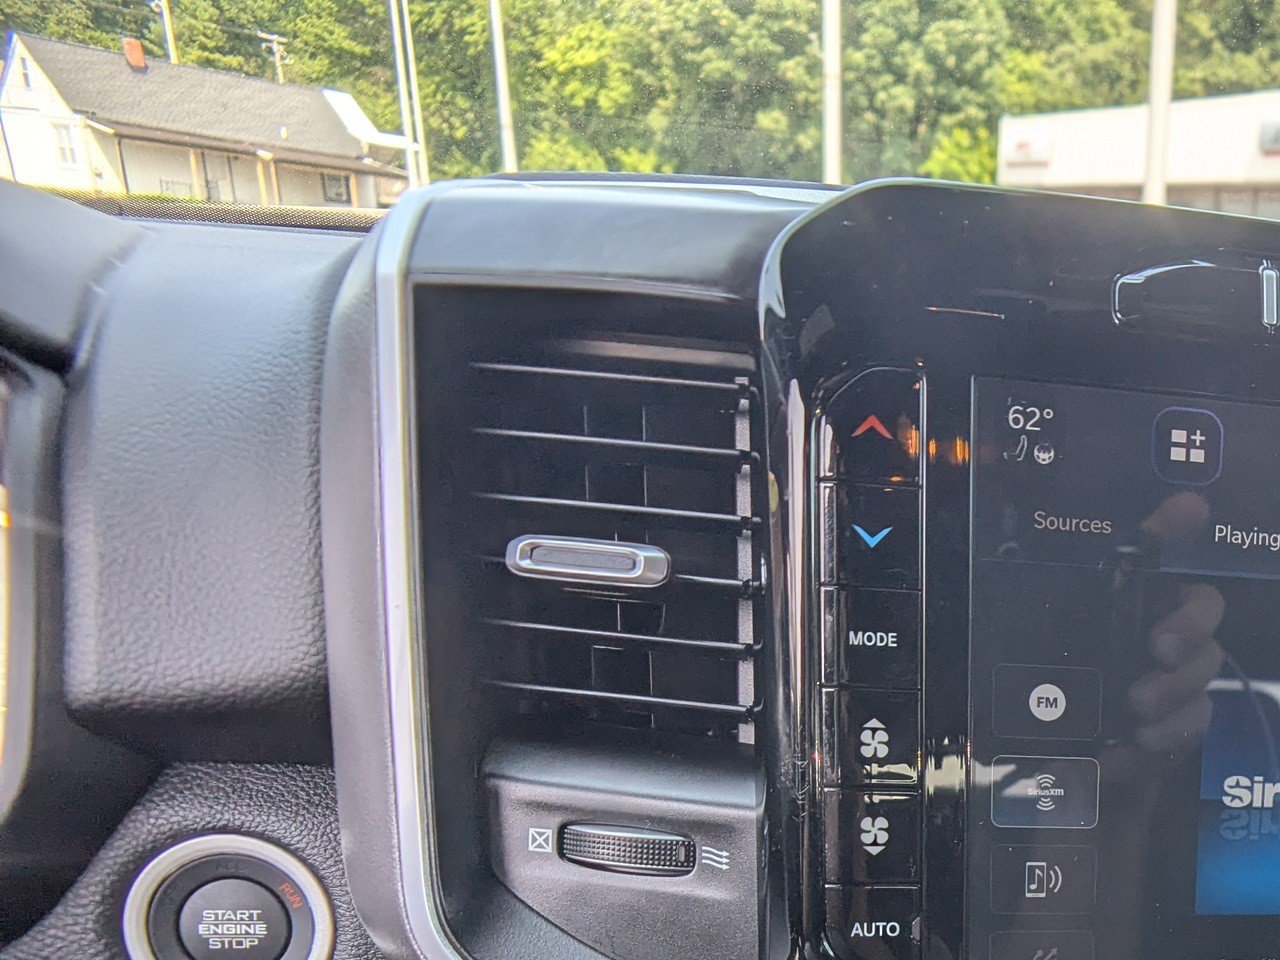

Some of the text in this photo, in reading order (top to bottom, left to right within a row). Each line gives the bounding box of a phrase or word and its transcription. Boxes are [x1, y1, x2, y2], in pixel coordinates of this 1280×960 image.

[1008, 404, 1053, 430] 62°
[1034, 511, 1112, 534] Sources
[1214, 525, 1280, 550] Playing
[849, 631, 898, 647] MODE
[1036, 696, 1059, 709] FM
[280, 882, 302, 908] RUN
[202, 910, 262, 921] START
[198, 924, 267, 935] ENGINE
[850, 921, 900, 937] AUTO
[208, 938, 259, 949] STOP
